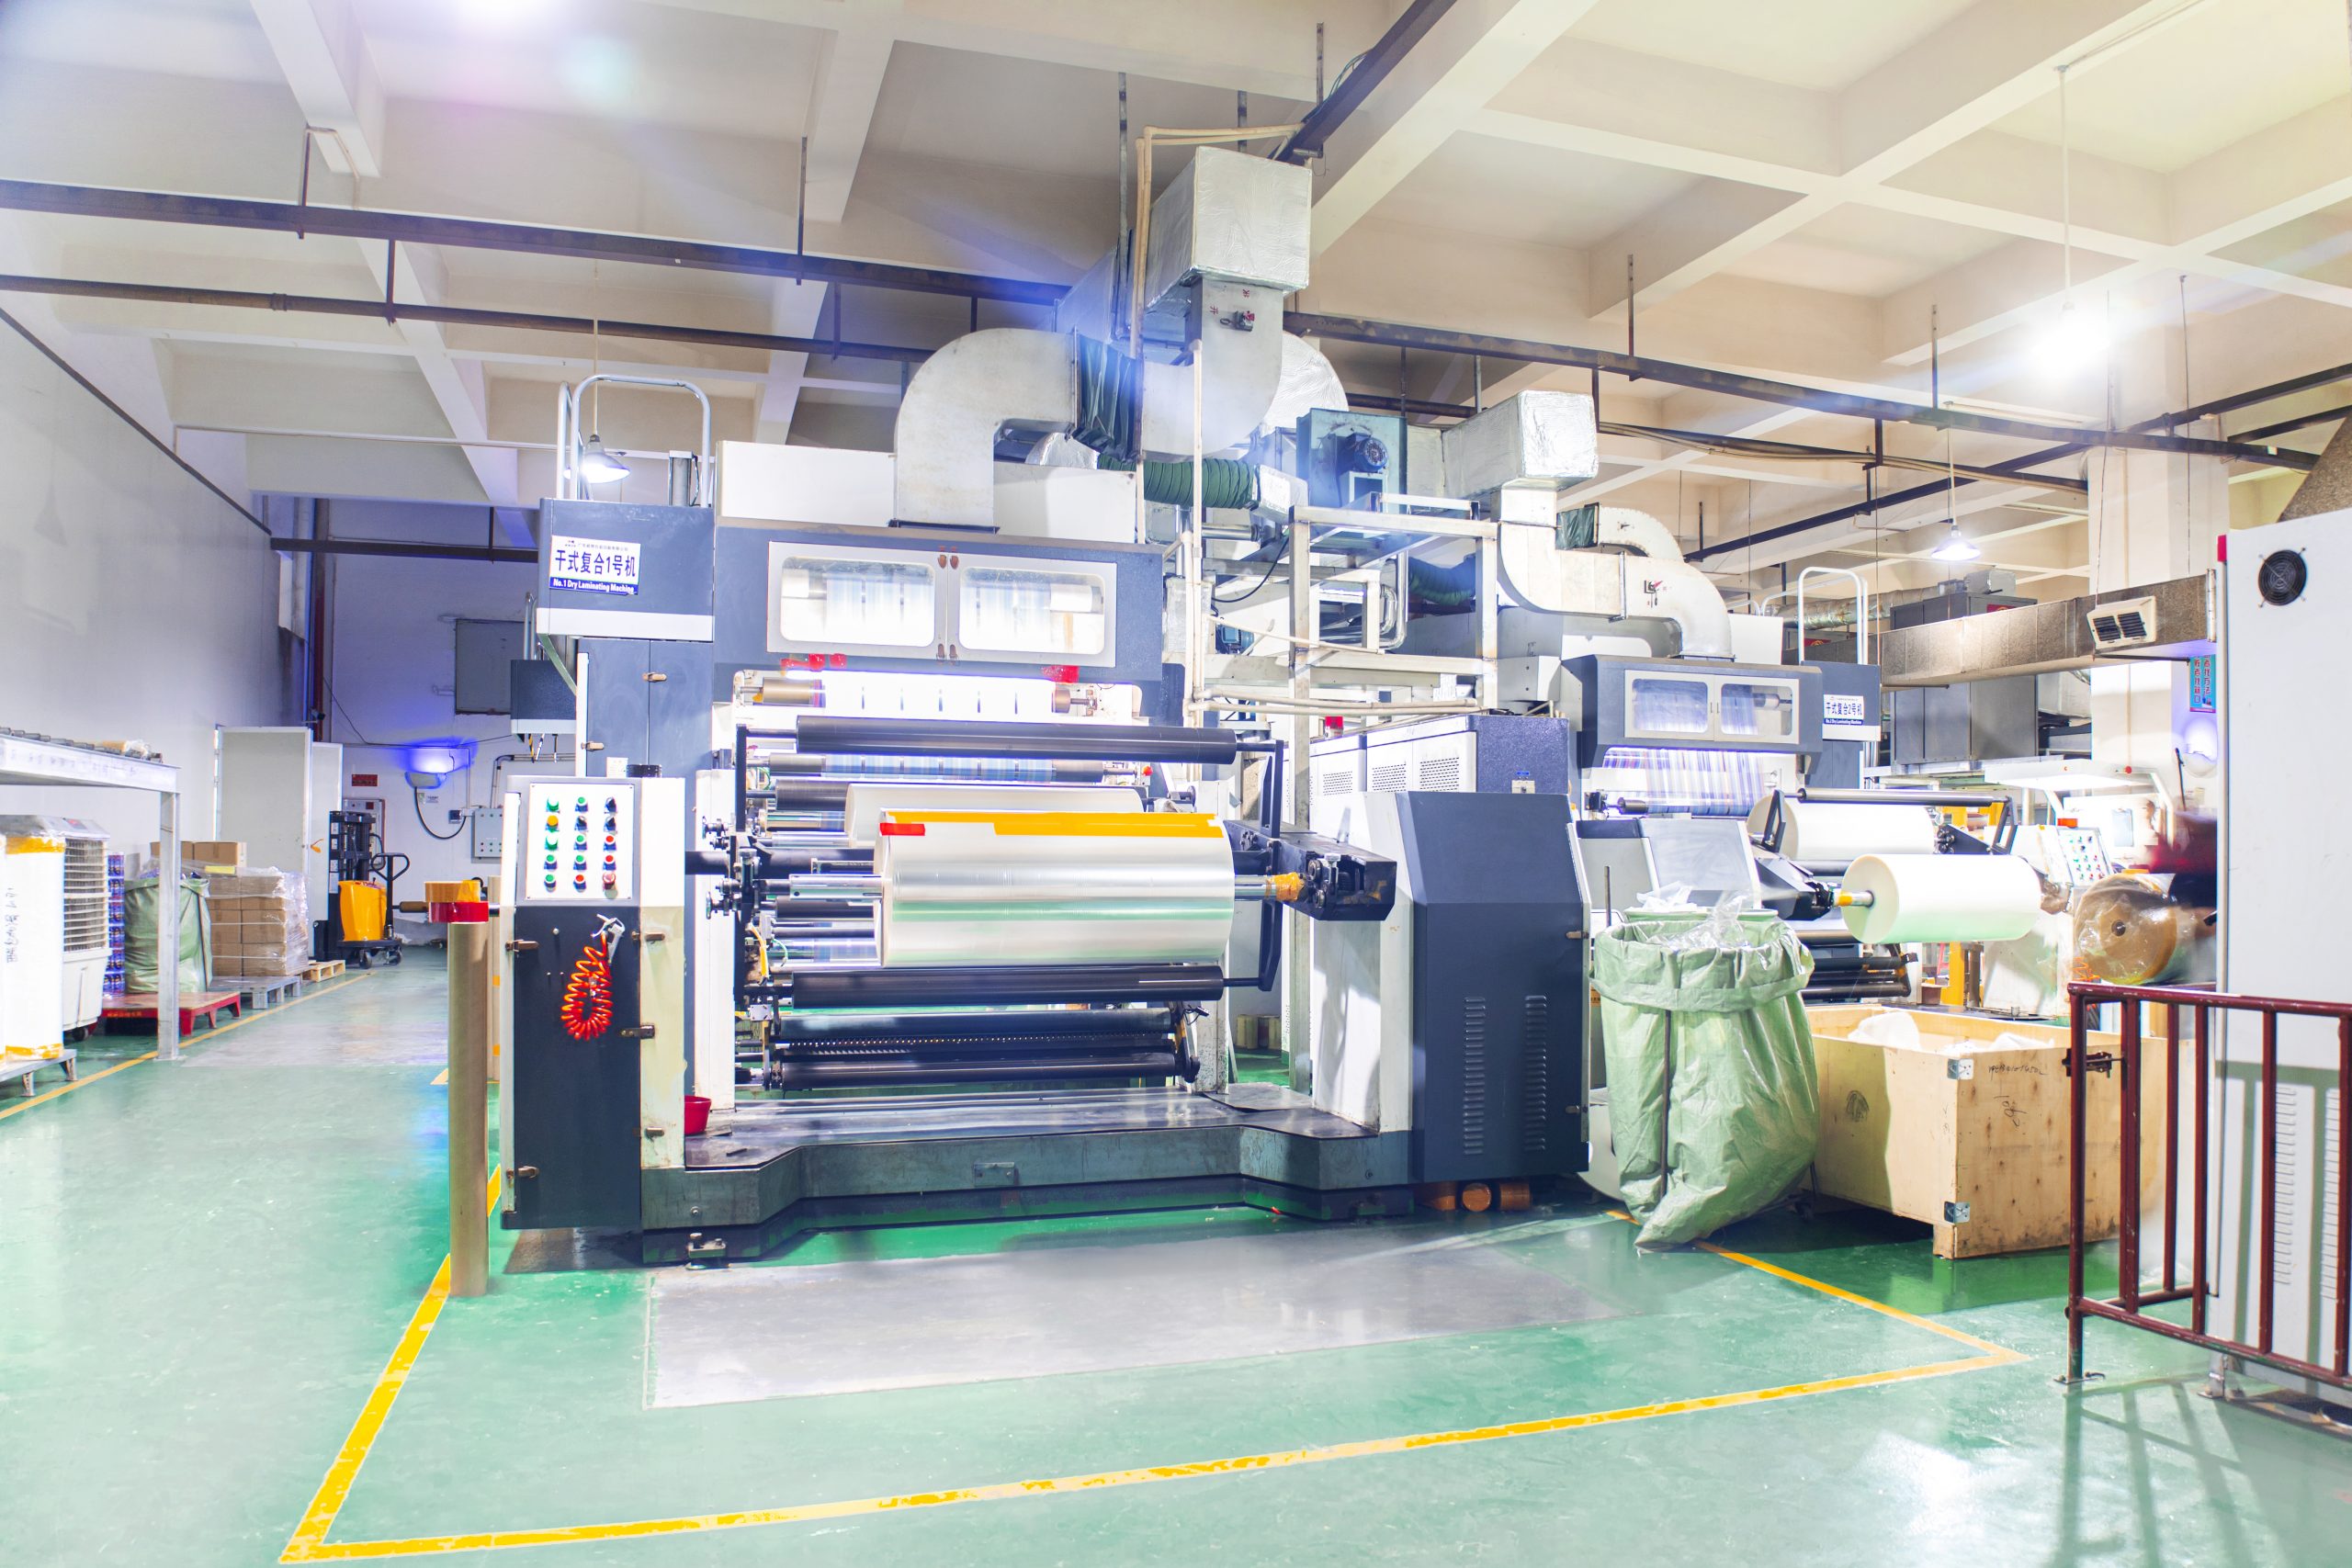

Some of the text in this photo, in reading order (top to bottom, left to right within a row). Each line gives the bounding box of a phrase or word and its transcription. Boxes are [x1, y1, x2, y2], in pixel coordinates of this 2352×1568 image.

[555, 549, 636, 577] 干式复合1号机
[553, 578, 566, 588] No.1
[567, 579, 578, 590] Dry
[578, 581, 610, 592] Laminating
[1826, 702, 1862, 716] 干式复合2号机
